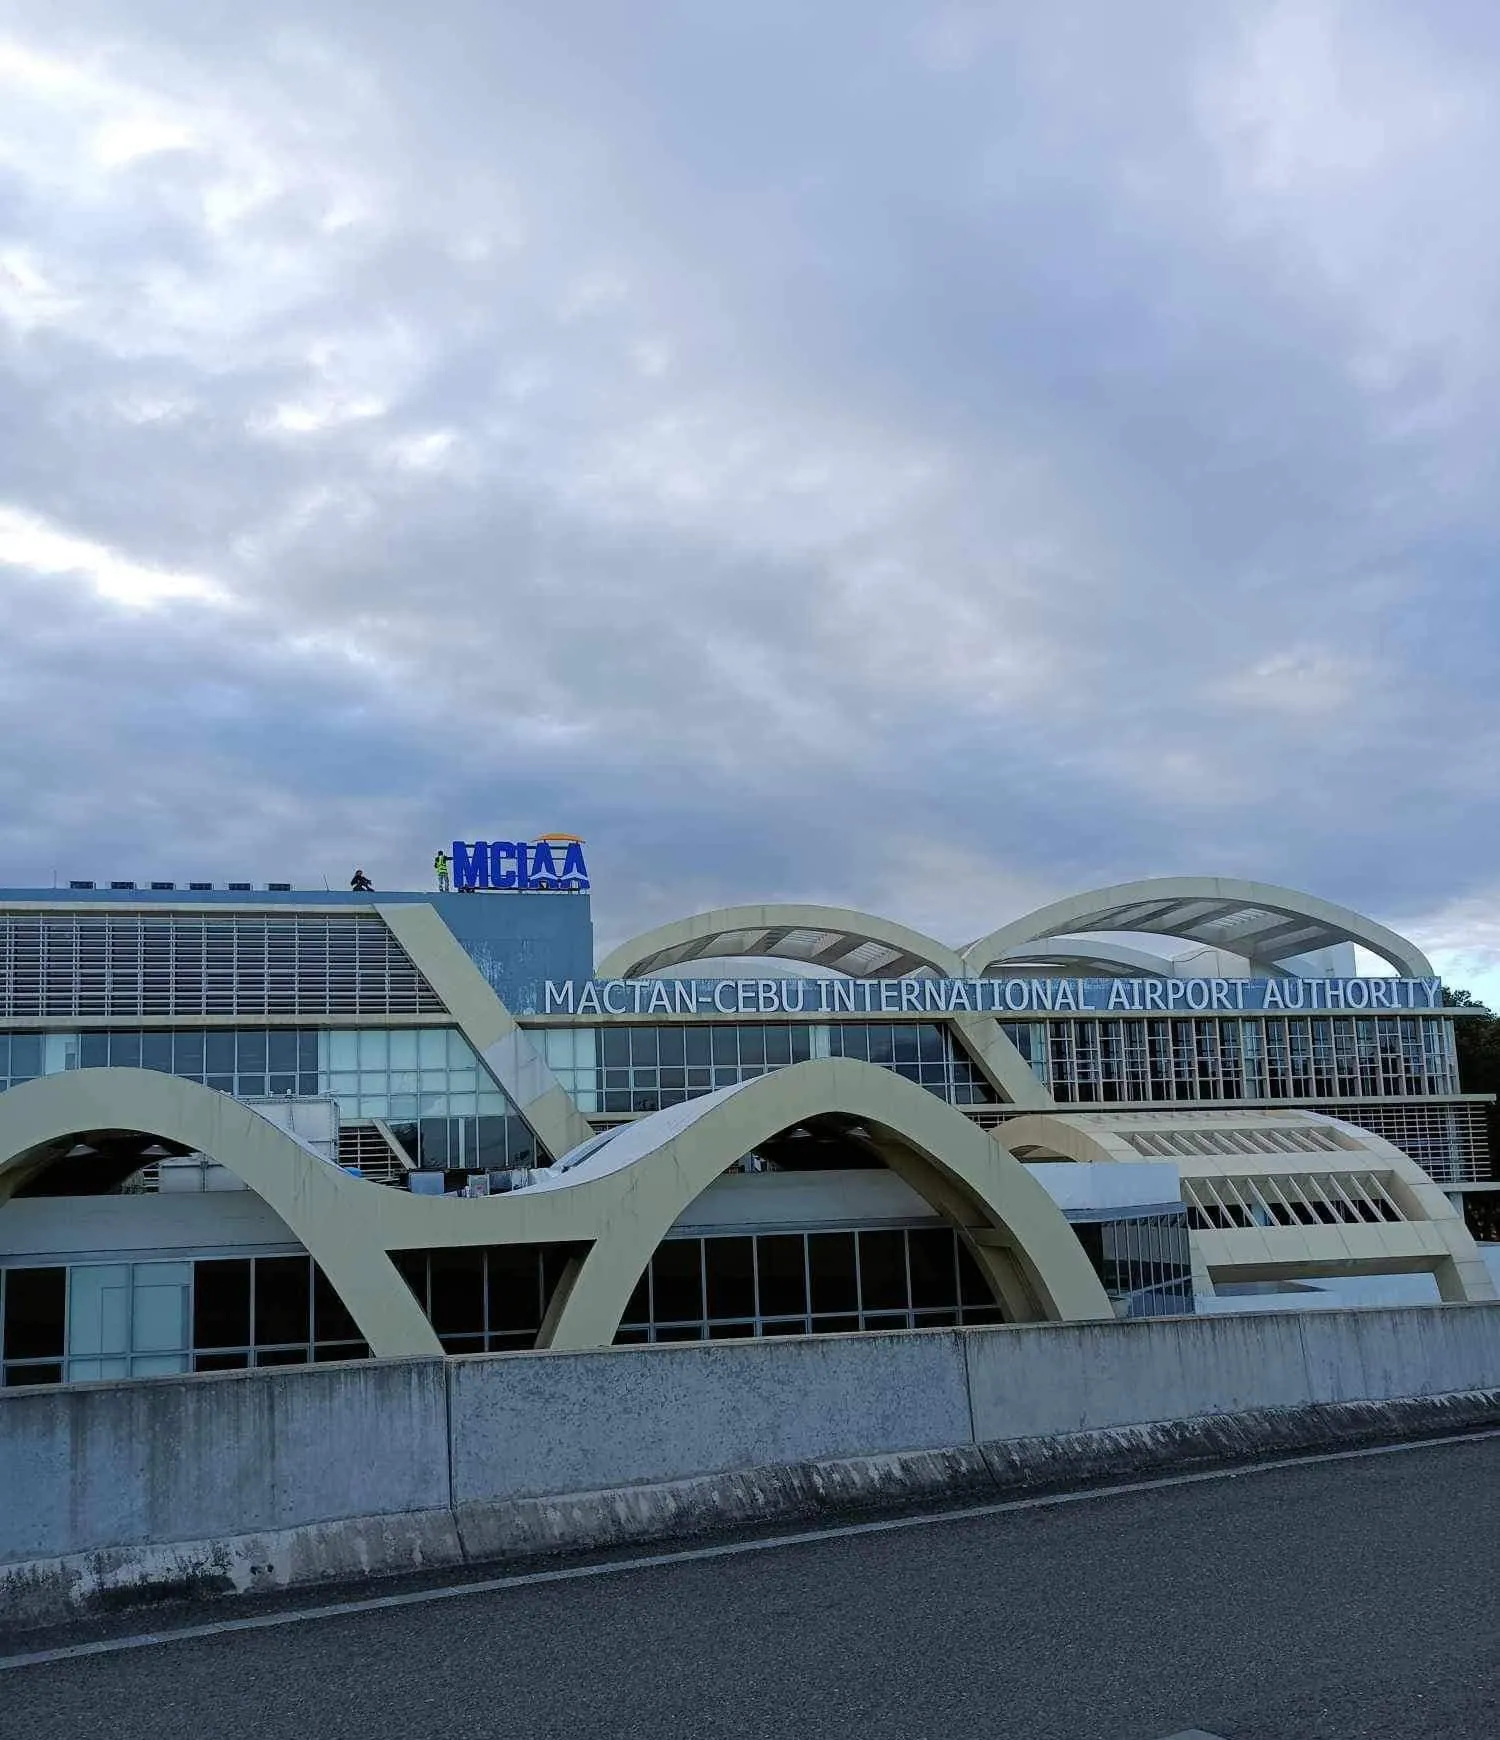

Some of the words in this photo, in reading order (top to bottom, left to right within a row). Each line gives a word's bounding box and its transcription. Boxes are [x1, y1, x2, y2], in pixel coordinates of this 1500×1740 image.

[453, 841, 590, 888] MCIAA
[544, 980, 804, 1014] MACTAN-CEBU
[817, 979, 1094, 1011] INTERNATIONAL
[1107, 979, 1247, 1010] AIRPORT
[1263, 977, 1440, 1009] AUTHORITY
